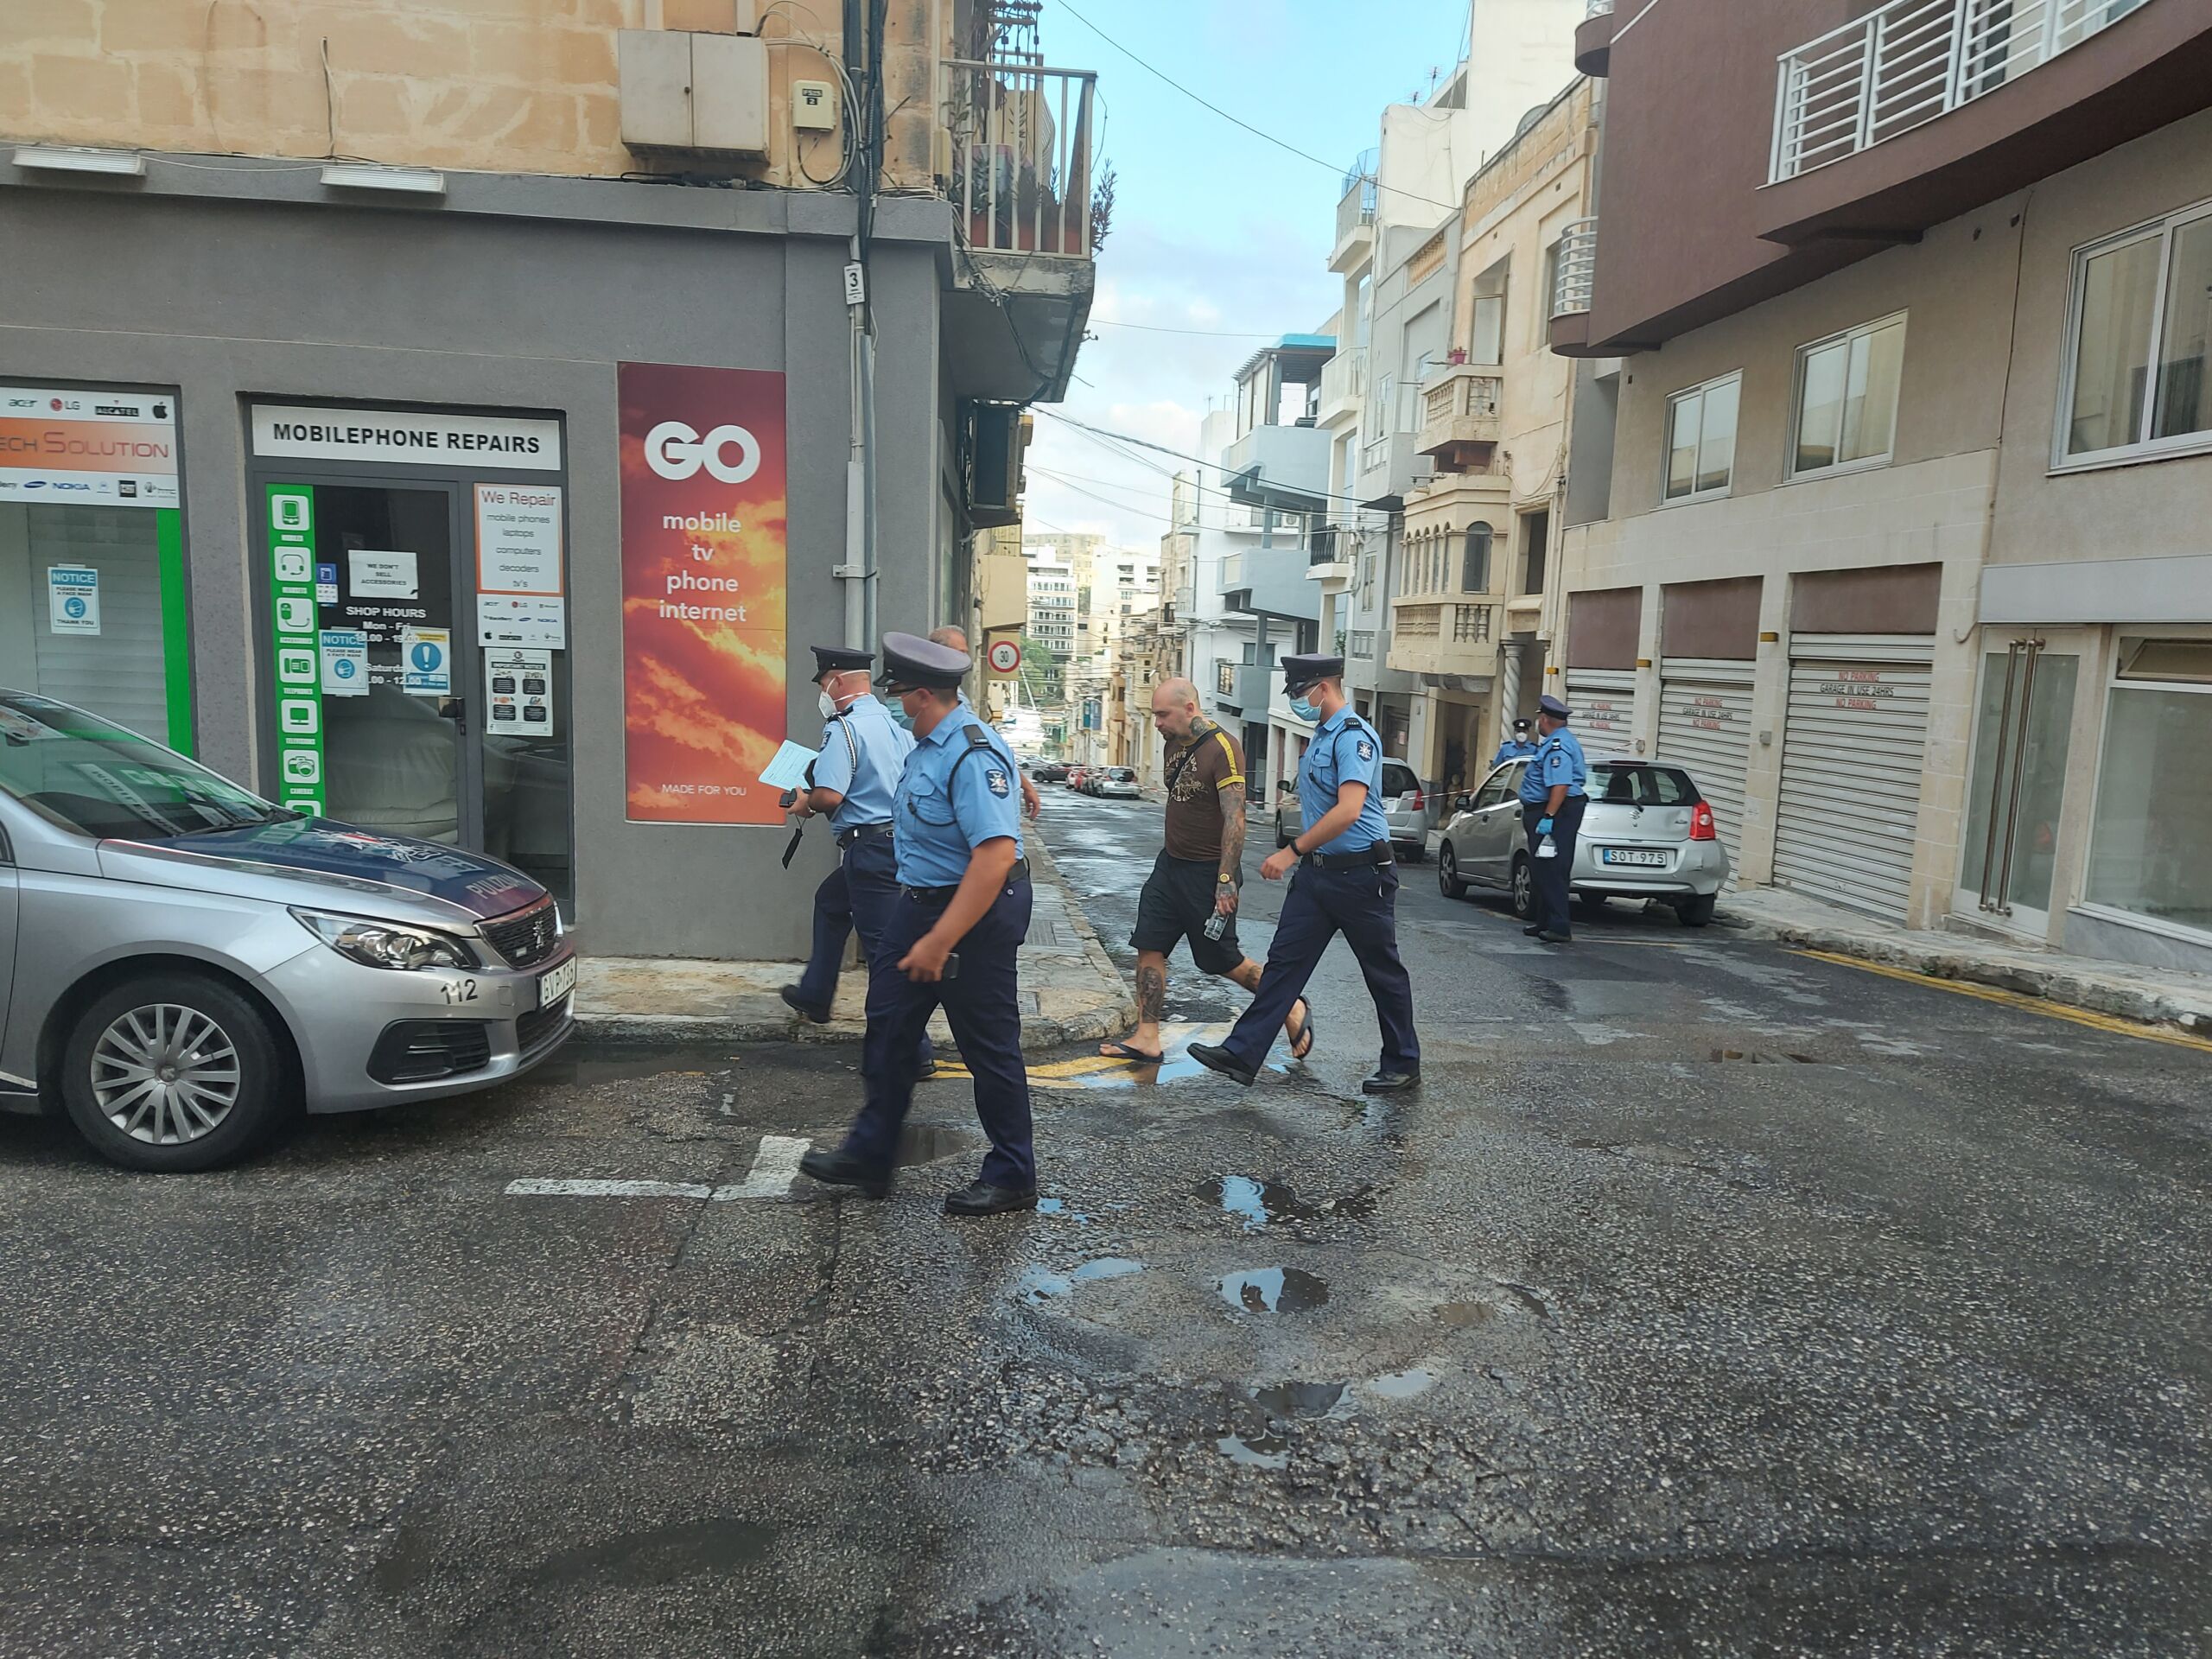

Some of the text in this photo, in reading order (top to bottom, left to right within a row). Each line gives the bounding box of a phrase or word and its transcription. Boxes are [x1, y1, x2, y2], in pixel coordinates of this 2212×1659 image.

[849, 272, 858, 288] 3
[8, 398, 37, 408] acer
[65, 400, 81, 410] LG
[43, 431, 168, 458] SOLUTION
[273, 423, 540, 454] MOBILEPHONE REPAIRS
[644, 421, 761, 484] GO
[481, 490, 556, 508] We Repair
[518, 515, 550, 524] phones
[663, 512, 742, 533] mobile
[503, 529, 535, 538] laptops
[495, 547, 542, 556] computers
[691, 544, 715, 561] tv
[499, 563, 540, 573] decoders
[53, 573, 95, 582] NOTICE
[666, 570, 739, 594] phone
[346, 606, 427, 619] SHOP HOURS
[659, 600, 747, 622] internet
[362, 620, 387, 630] Mon
[1000, 651, 1009, 663] 30
[1839, 671, 1880, 683] NO PARKING
[1820, 683, 1894, 697] GARAGE IN USE 24HRS
[1694, 697, 1701, 706] NO
[1836, 697, 1877, 710] NO PARKING
[1693, 718, 1700, 728] NO
[662, 784, 747, 796] MADE FOR YOU
[1640, 853, 1664, 864] 975
[441, 979, 478, 1004] 112
